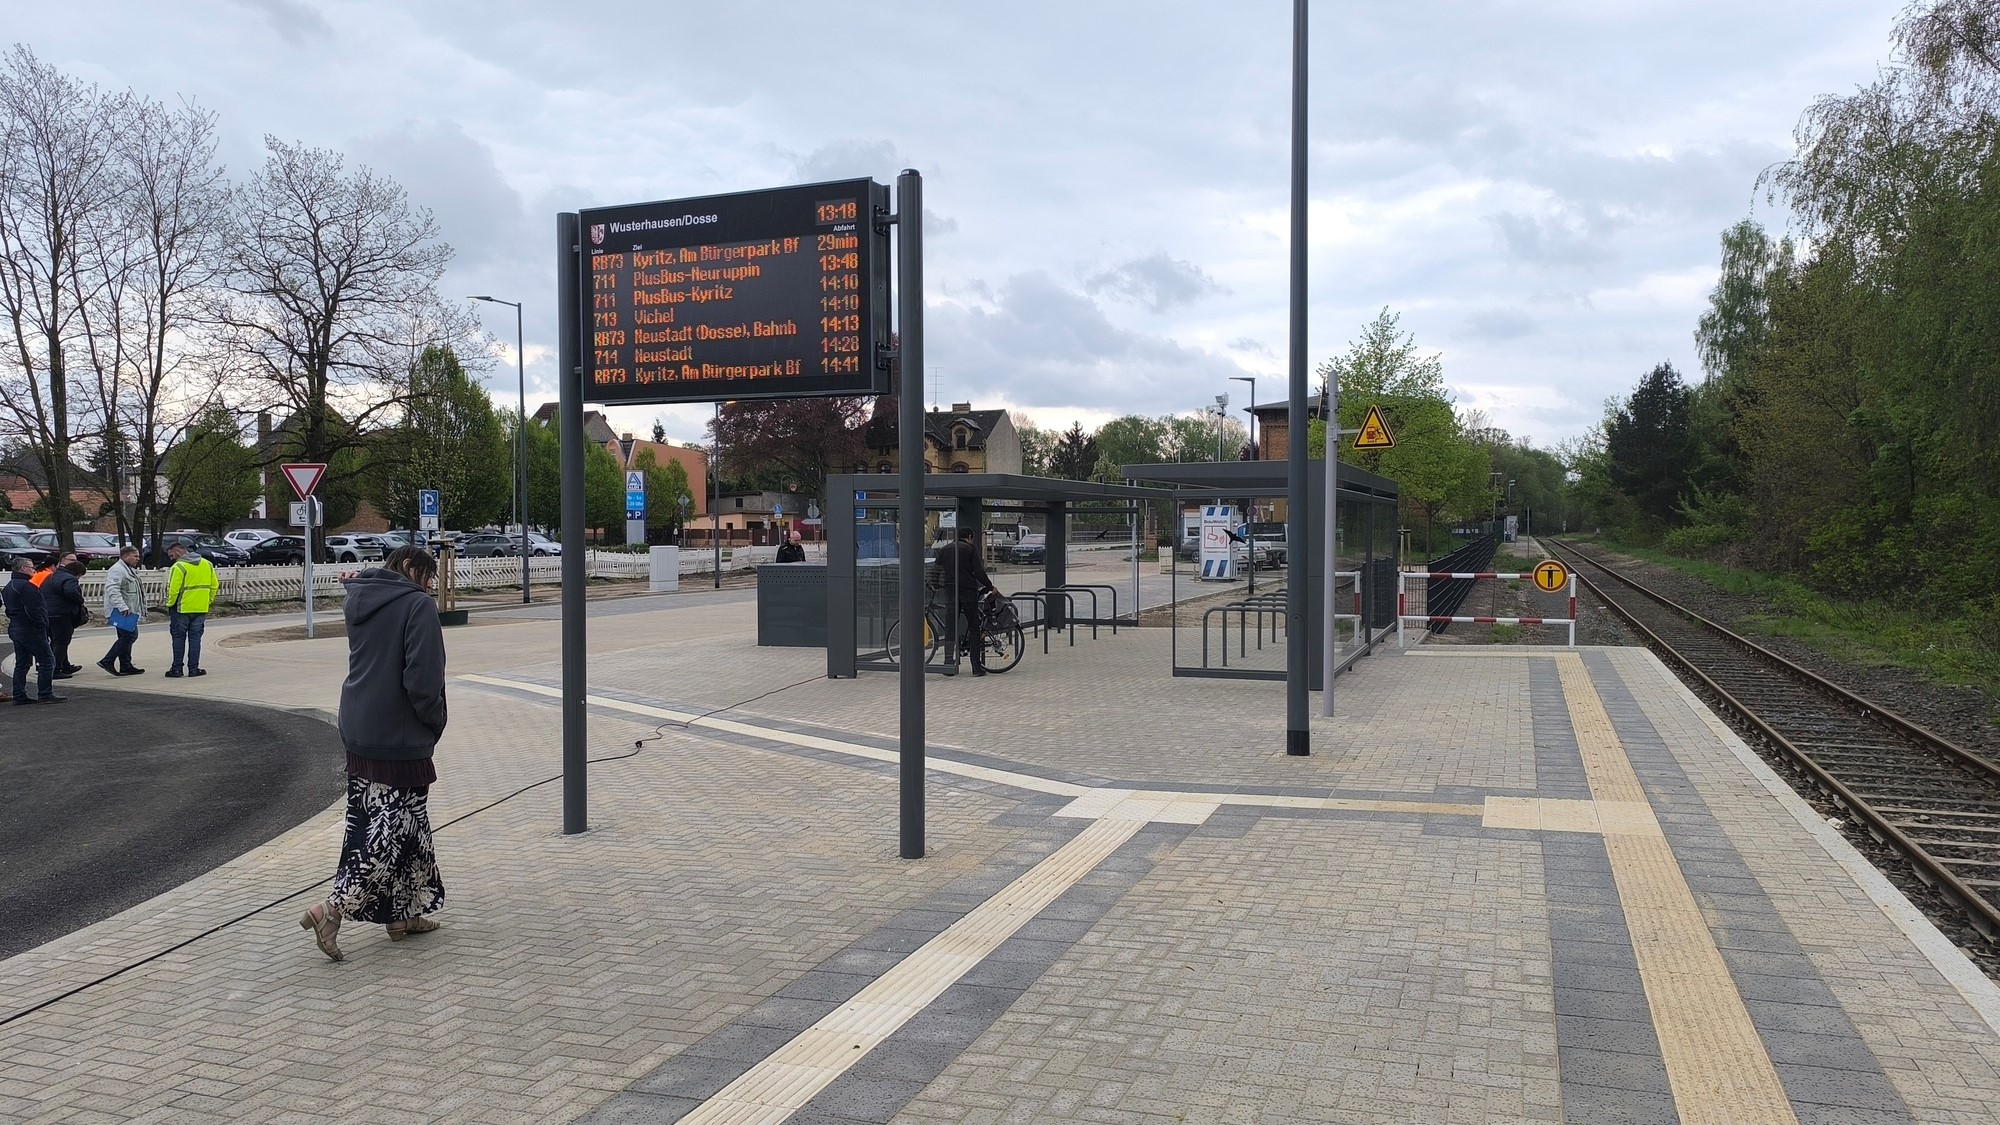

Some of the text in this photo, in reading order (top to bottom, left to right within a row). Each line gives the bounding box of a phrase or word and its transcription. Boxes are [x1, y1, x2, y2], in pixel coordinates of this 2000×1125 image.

[609, 214, 718, 233] Wusterhausen/Dosse
[817, 202, 857, 221] 13:18
[833, 223, 856, 232] Abfahrt
[592, 232, 858, 271] RB73 Kyritz, Am Bürgerpark Bf 29min
[593, 252, 859, 290] 711 PlusBus-Neuruppin 13:48
[593, 273, 859, 309] 711 PlusBus-Kyritz 14:10
[593, 294, 859, 327] 713 Vichel 14:10
[594, 314, 859, 347] RB73 Neustadt (Dosse), Bahnh 14:13
[594, 335, 860, 365] 714 Neustadt 14:28
[594, 356, 859, 385] RB73 Kyritz, Am Bürgerpark Bf 14:41
[424, 493, 435, 512] P
[635, 511, 642, 519] P
